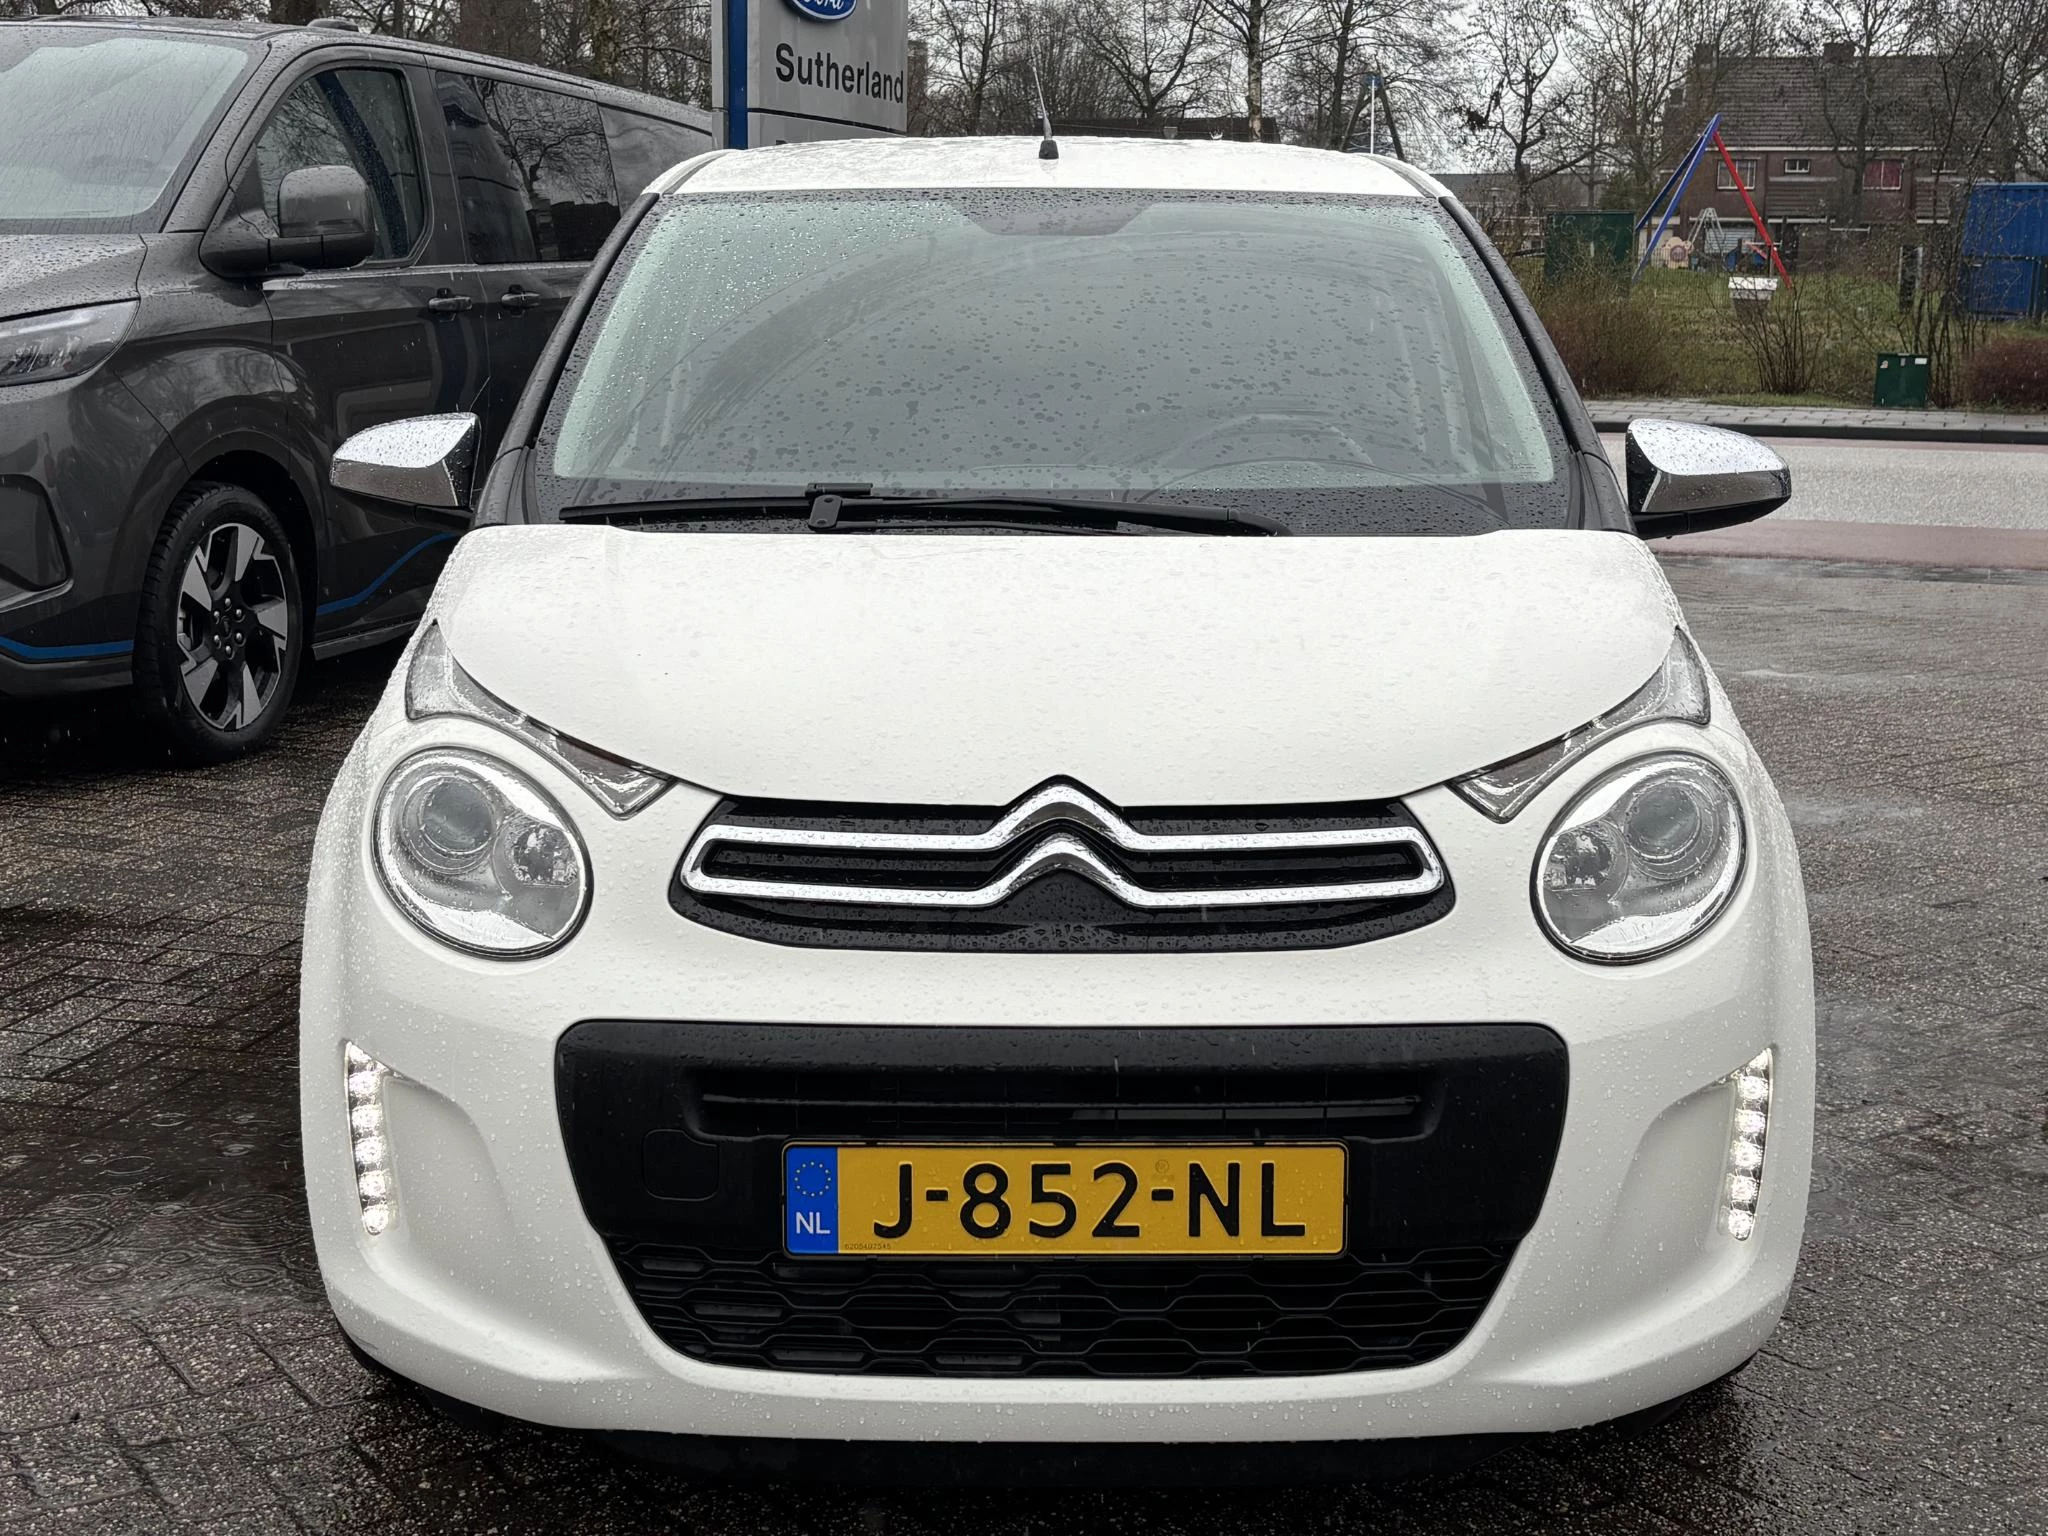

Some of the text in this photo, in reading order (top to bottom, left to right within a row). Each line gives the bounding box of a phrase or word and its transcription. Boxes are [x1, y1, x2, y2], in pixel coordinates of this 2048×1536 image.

[775, 43, 904, 104] Sutherland
[795, 1211, 831, 1235] NL
[873, 1161, 1306, 1240] J-852-NL
